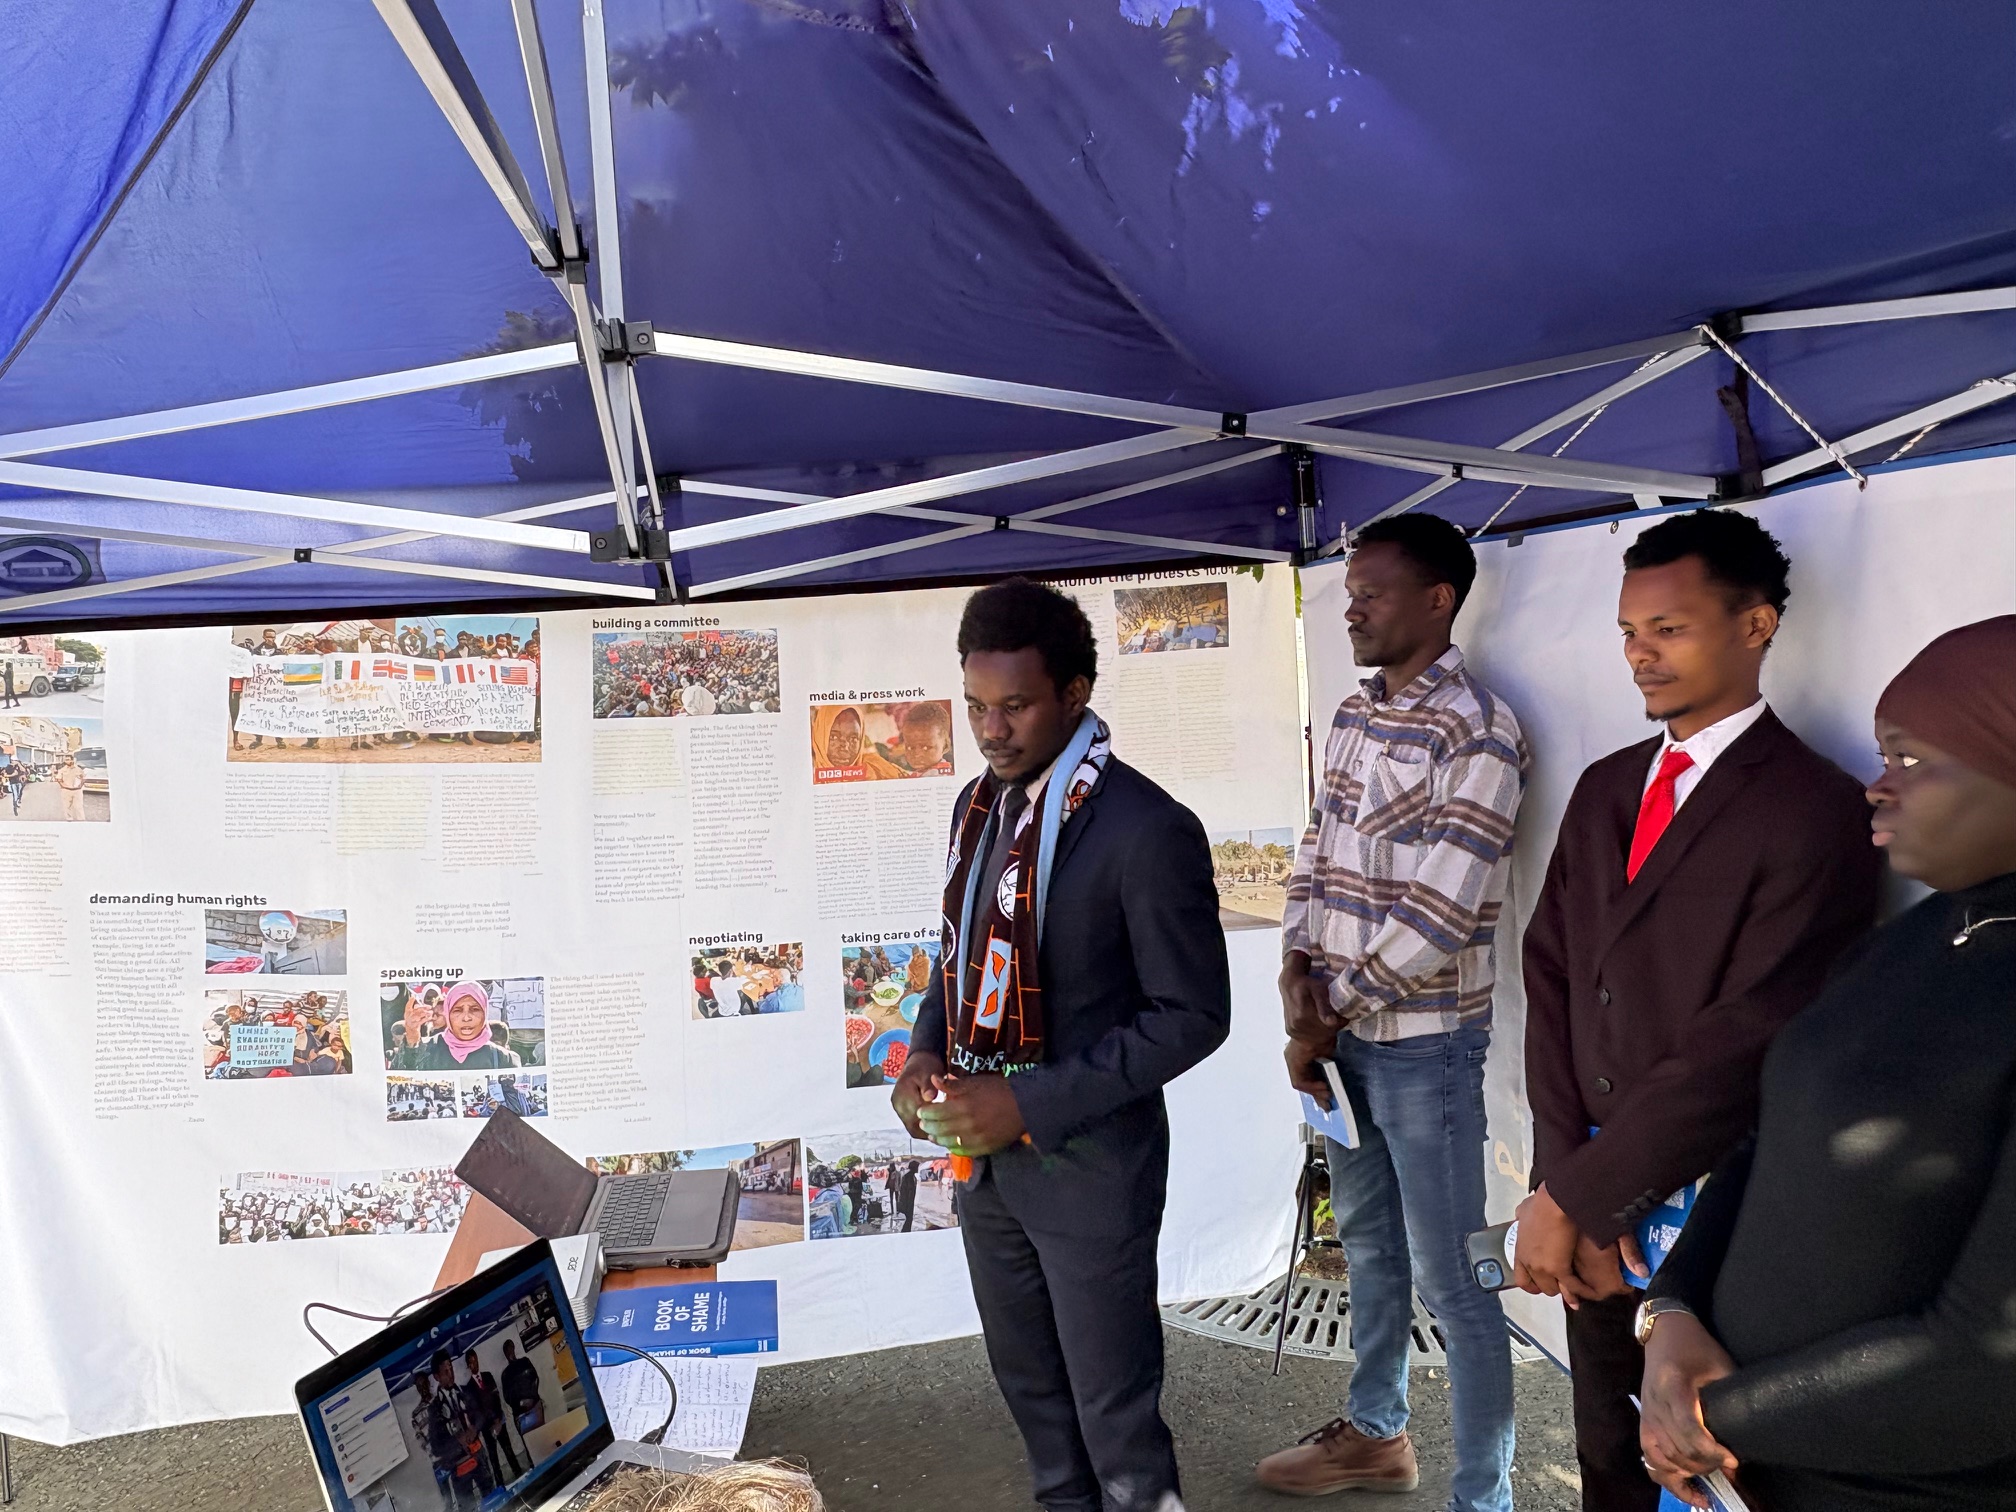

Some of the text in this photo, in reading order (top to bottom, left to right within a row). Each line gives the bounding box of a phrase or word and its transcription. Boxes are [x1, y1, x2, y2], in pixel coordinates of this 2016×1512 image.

[1138, 568, 1200, 584] protests
[592, 616, 720, 630] building a committee
[809, 687, 925, 702] media & press work
[843, 769, 863, 777] NEWS
[90, 893, 267, 907] demanding human rights
[689, 932, 763, 946] negotiating
[841, 932, 880, 943] taking
[884, 931, 910, 940] care
[914, 928, 926, 938] of
[380, 967, 463, 979] speaking up
[654, 1298, 674, 1332] BOOK
[674, 1305, 690, 1321] OF
[691, 1292, 710, 1332] SHAME
